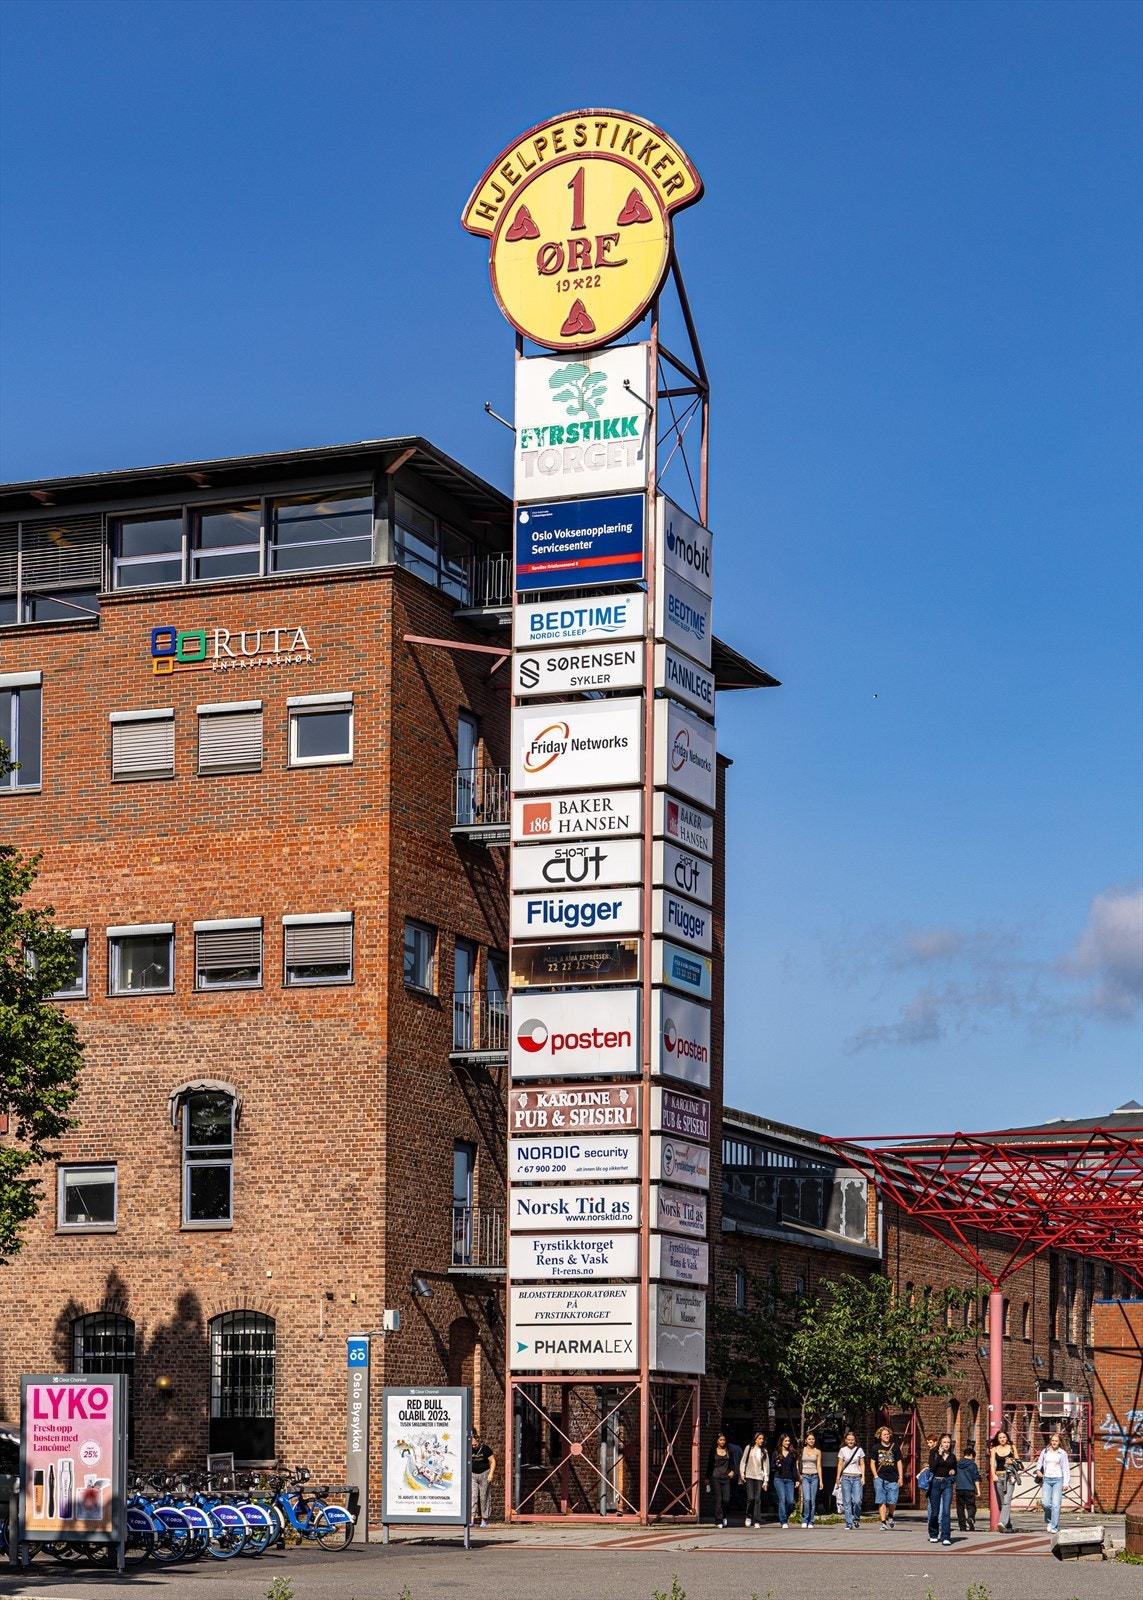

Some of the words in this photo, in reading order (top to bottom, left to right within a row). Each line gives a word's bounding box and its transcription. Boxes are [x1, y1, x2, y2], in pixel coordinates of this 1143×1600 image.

[475, 121, 685, 221] HJELPESTIKKER
[568, 166, 586, 231] 1
[536, 232, 627, 276] ØRE
[520, 415, 639, 449] FYRSTIKK
[520, 438, 641, 479] TORGET
[531, 531, 553, 542] Oslo
[554, 523, 633, 539] Voksenopplæring
[531, 540, 593, 554] Servicesenter
[675, 535, 709, 578] mobit
[530, 605, 626, 632] BEDTIME
[668, 594, 705, 634] BEDTIME
[212, 626, 312, 659] RUTA
[530, 631, 560, 640] NORDIC
[562, 629, 587, 638] SLEEP
[212, 654, 313, 671] ENTREPRENØR
[546, 650, 635, 672] SØRENSEN
[570, 674, 611, 686] SYKLER
[666, 656, 712, 704] TANNLEGE
[531, 740, 568, 755] Friday
[571, 735, 628, 751] Networks
[673, 740, 688, 762] Friday
[689, 749, 711, 773] Networks
[558, 798, 613, 814] BAKER
[558, 815, 629, 833] HANSEN
[680, 808, 702, 831] BAKER
[680, 826, 708, 851] HANSEN
[554, 847, 589, 858] SHORT
[527, 899, 622, 928] Flügger
[668, 900, 705, 939] Flügger
[548, 963, 558, 972] 22
[551, 1027, 631, 1055] posten
[677, 1038, 708, 1064] posten
[536, 1091, 610, 1107] KAROLINE
[671, 1096, 700, 1115] KAROLINE
[514, 1110, 548, 1128] PUB
[551, 1109, 565, 1127] &
[569, 1106, 633, 1126] SPISERI
[662, 1109, 676, 1128] PUB
[676, 1113, 682, 1130] &
[683, 1115, 708, 1137] SPISERI
[517, 1145, 580, 1160] NORDIC
[584, 1147, 629, 1159] security
[524, 1165, 534, 1173] 67
[535, 1165, 551, 1173] 900
[551, 1164, 566, 1172] 200
[516, 1198, 569, 1215] Norsk
[576, 1197, 605, 1214] Tid
[611, 1200, 630, 1213] as
[660, 1198, 681, 1218] Norsk
[683, 1203, 694, 1221] Tid
[695, 1209, 704, 1223] as
[565, 1212, 633, 1221] www.norsktid.no
[533, 1239, 614, 1254] Fyrstikktorget
[536, 1254, 564, 1266] Rens
[567, 1254, 578, 1264] &
[581, 1253, 609, 1264] Vask
[670, 1256, 682, 1268] Rens
[687, 1258, 698, 1270] Vask
[552, 1267, 594, 1276] Ft-rens.no
[518, 1290, 627, 1299] BLOMSTERDEKORATØREN
[566, 1299, 578, 1309] PÅ
[534, 1311, 611, 1319] FYRSTIKKTORGET
[534, 1339, 633, 1354] PHARMALEX
[352, 1373, 363, 1399] Oslo
[33, 1387, 109, 1420] LYKO
[406, 1399, 422, 1410] RED
[424, 1399, 443, 1410] BULL
[398, 1410, 426, 1421] OLABIL
[428, 1410, 451, 1421] 2023.
[33, 1424, 56, 1432] Fresh
[56, 1425, 73, 1434] opp
[351, 1402, 362, 1453] Bysykkel
[61, 1434, 79, 1442] med
[33, 1443, 71, 1452] Lancôme!
[83, 1450, 98, 1458] 25%
